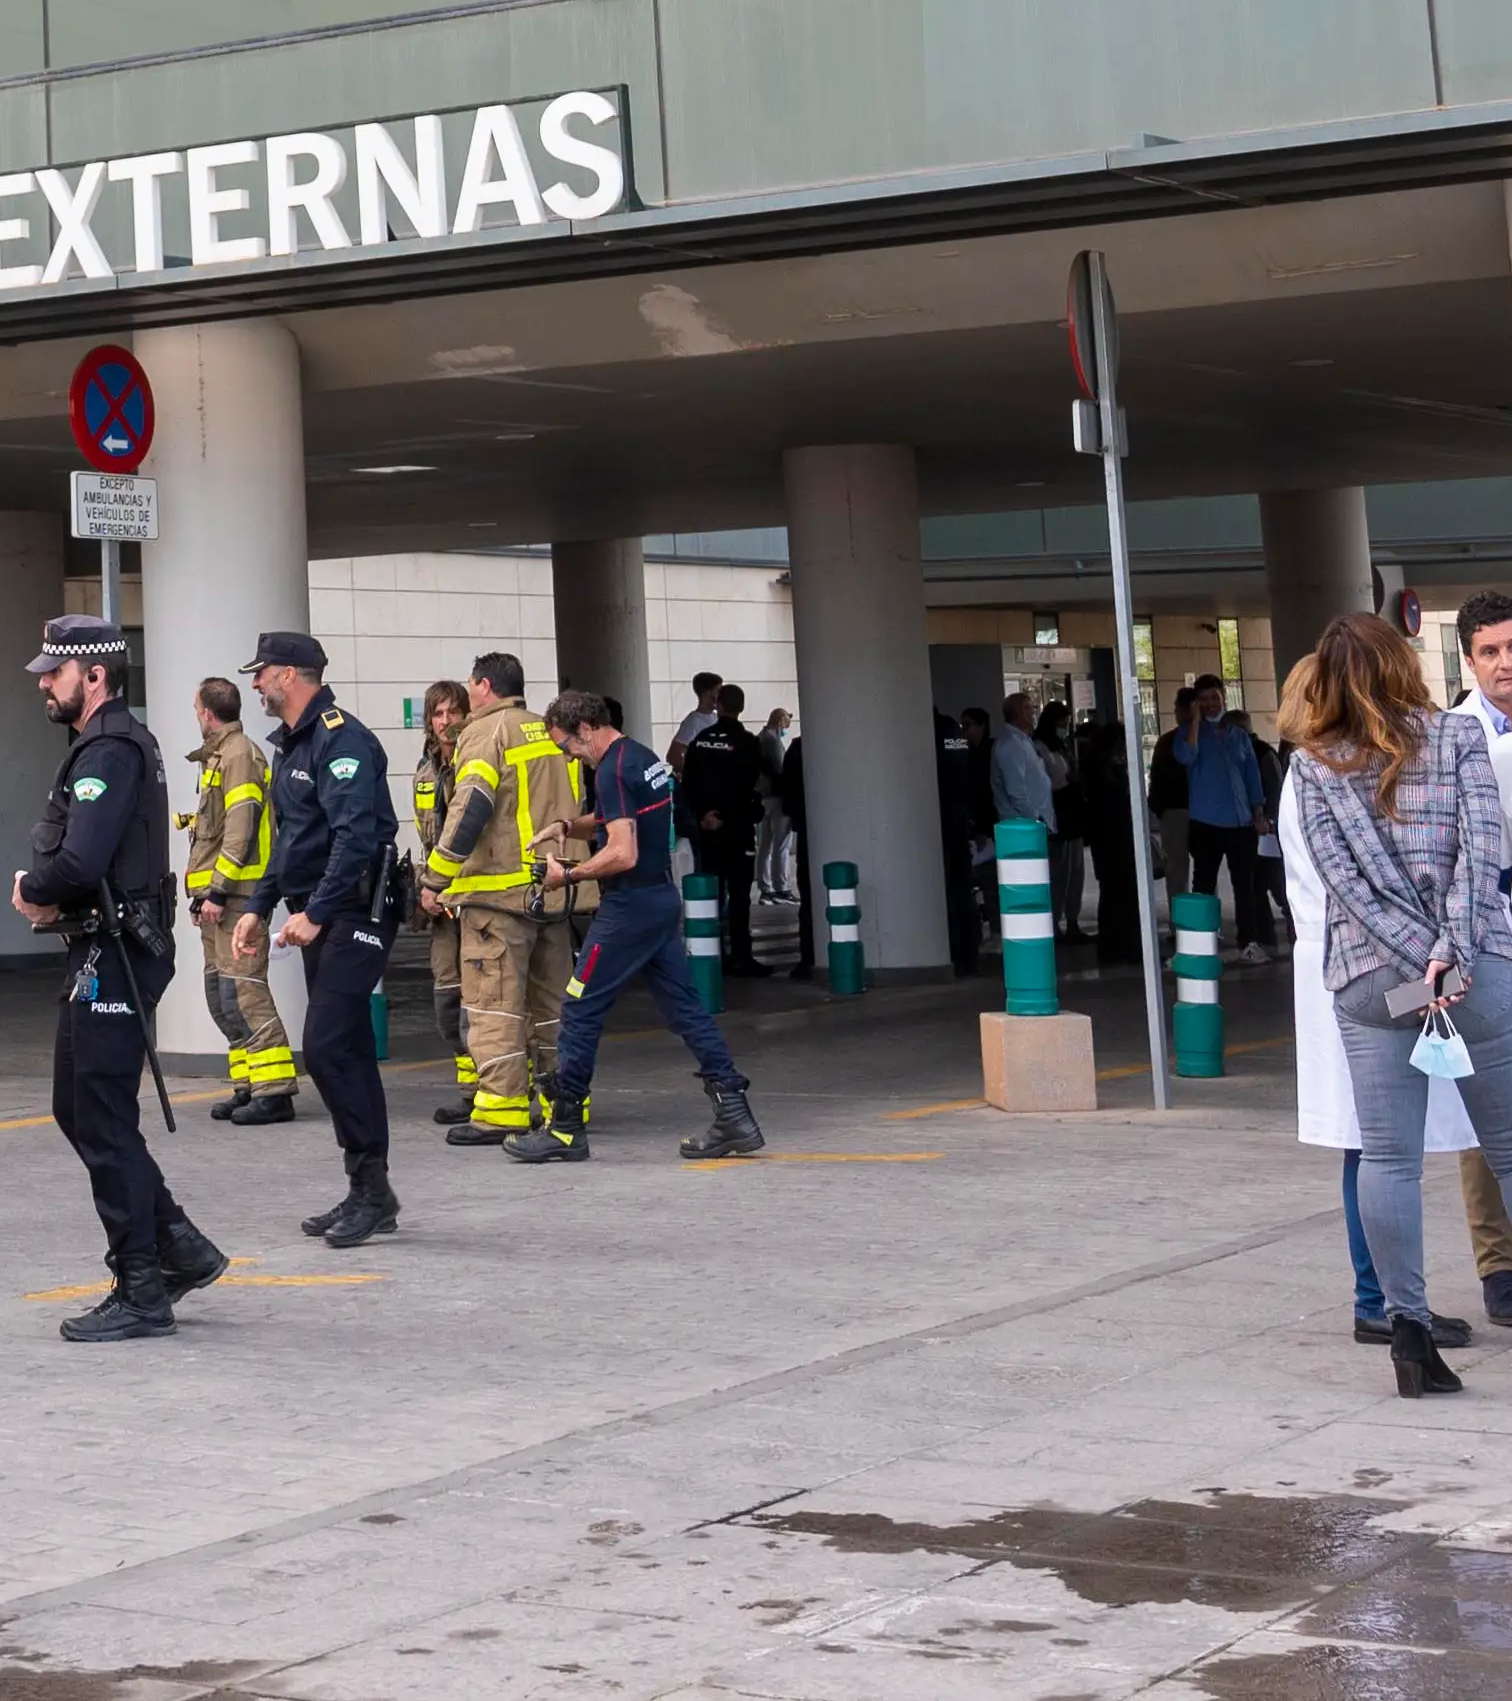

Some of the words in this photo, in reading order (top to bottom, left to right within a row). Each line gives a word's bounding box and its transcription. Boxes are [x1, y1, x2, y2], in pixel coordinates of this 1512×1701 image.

[99, 477, 134, 491] EXCEPTO
[83, 492, 143, 506] AMBULANCIAS
[146, 495, 152, 507] Y
[85, 506, 135, 521] VEHÍCULOS
[139, 510, 150, 522] DE
[89, 522, 148, 537] EMERGENCIAS
[696, 740, 729, 750] POLICIA
[91, 1002, 128, 1014] POLICIA
